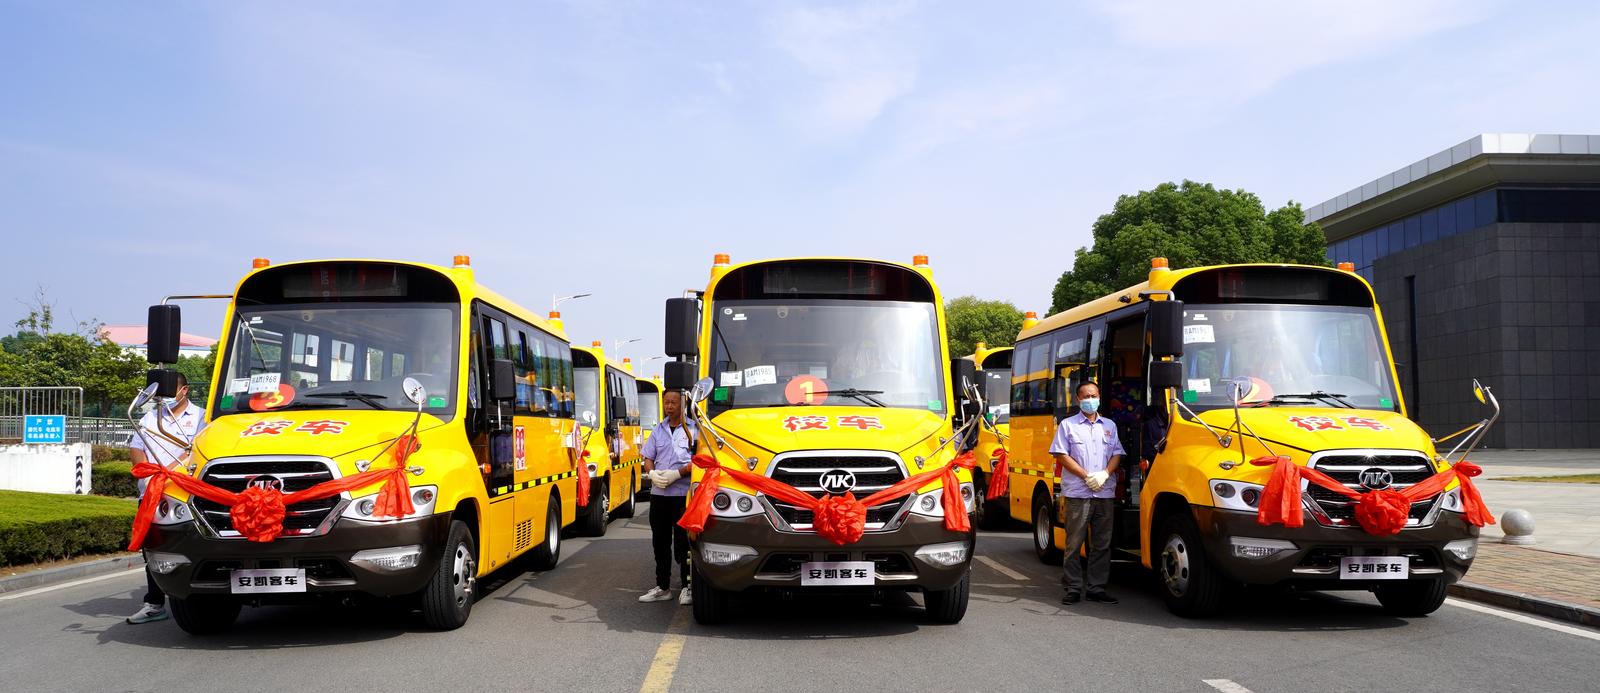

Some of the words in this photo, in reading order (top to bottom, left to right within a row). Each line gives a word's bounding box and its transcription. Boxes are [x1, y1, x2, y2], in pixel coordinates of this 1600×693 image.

[251, 375, 277, 384] AM1968
[800, 381, 813, 402] 1
[240, 420, 348, 436] 校车
[783, 415, 883, 431] 校车
[1289, 416, 1393, 431] 校车
[809, 569, 867, 579] 安凯客车
[1348, 563, 1402, 573] 安凯客车
[238, 576, 298, 587] 安凯客车
